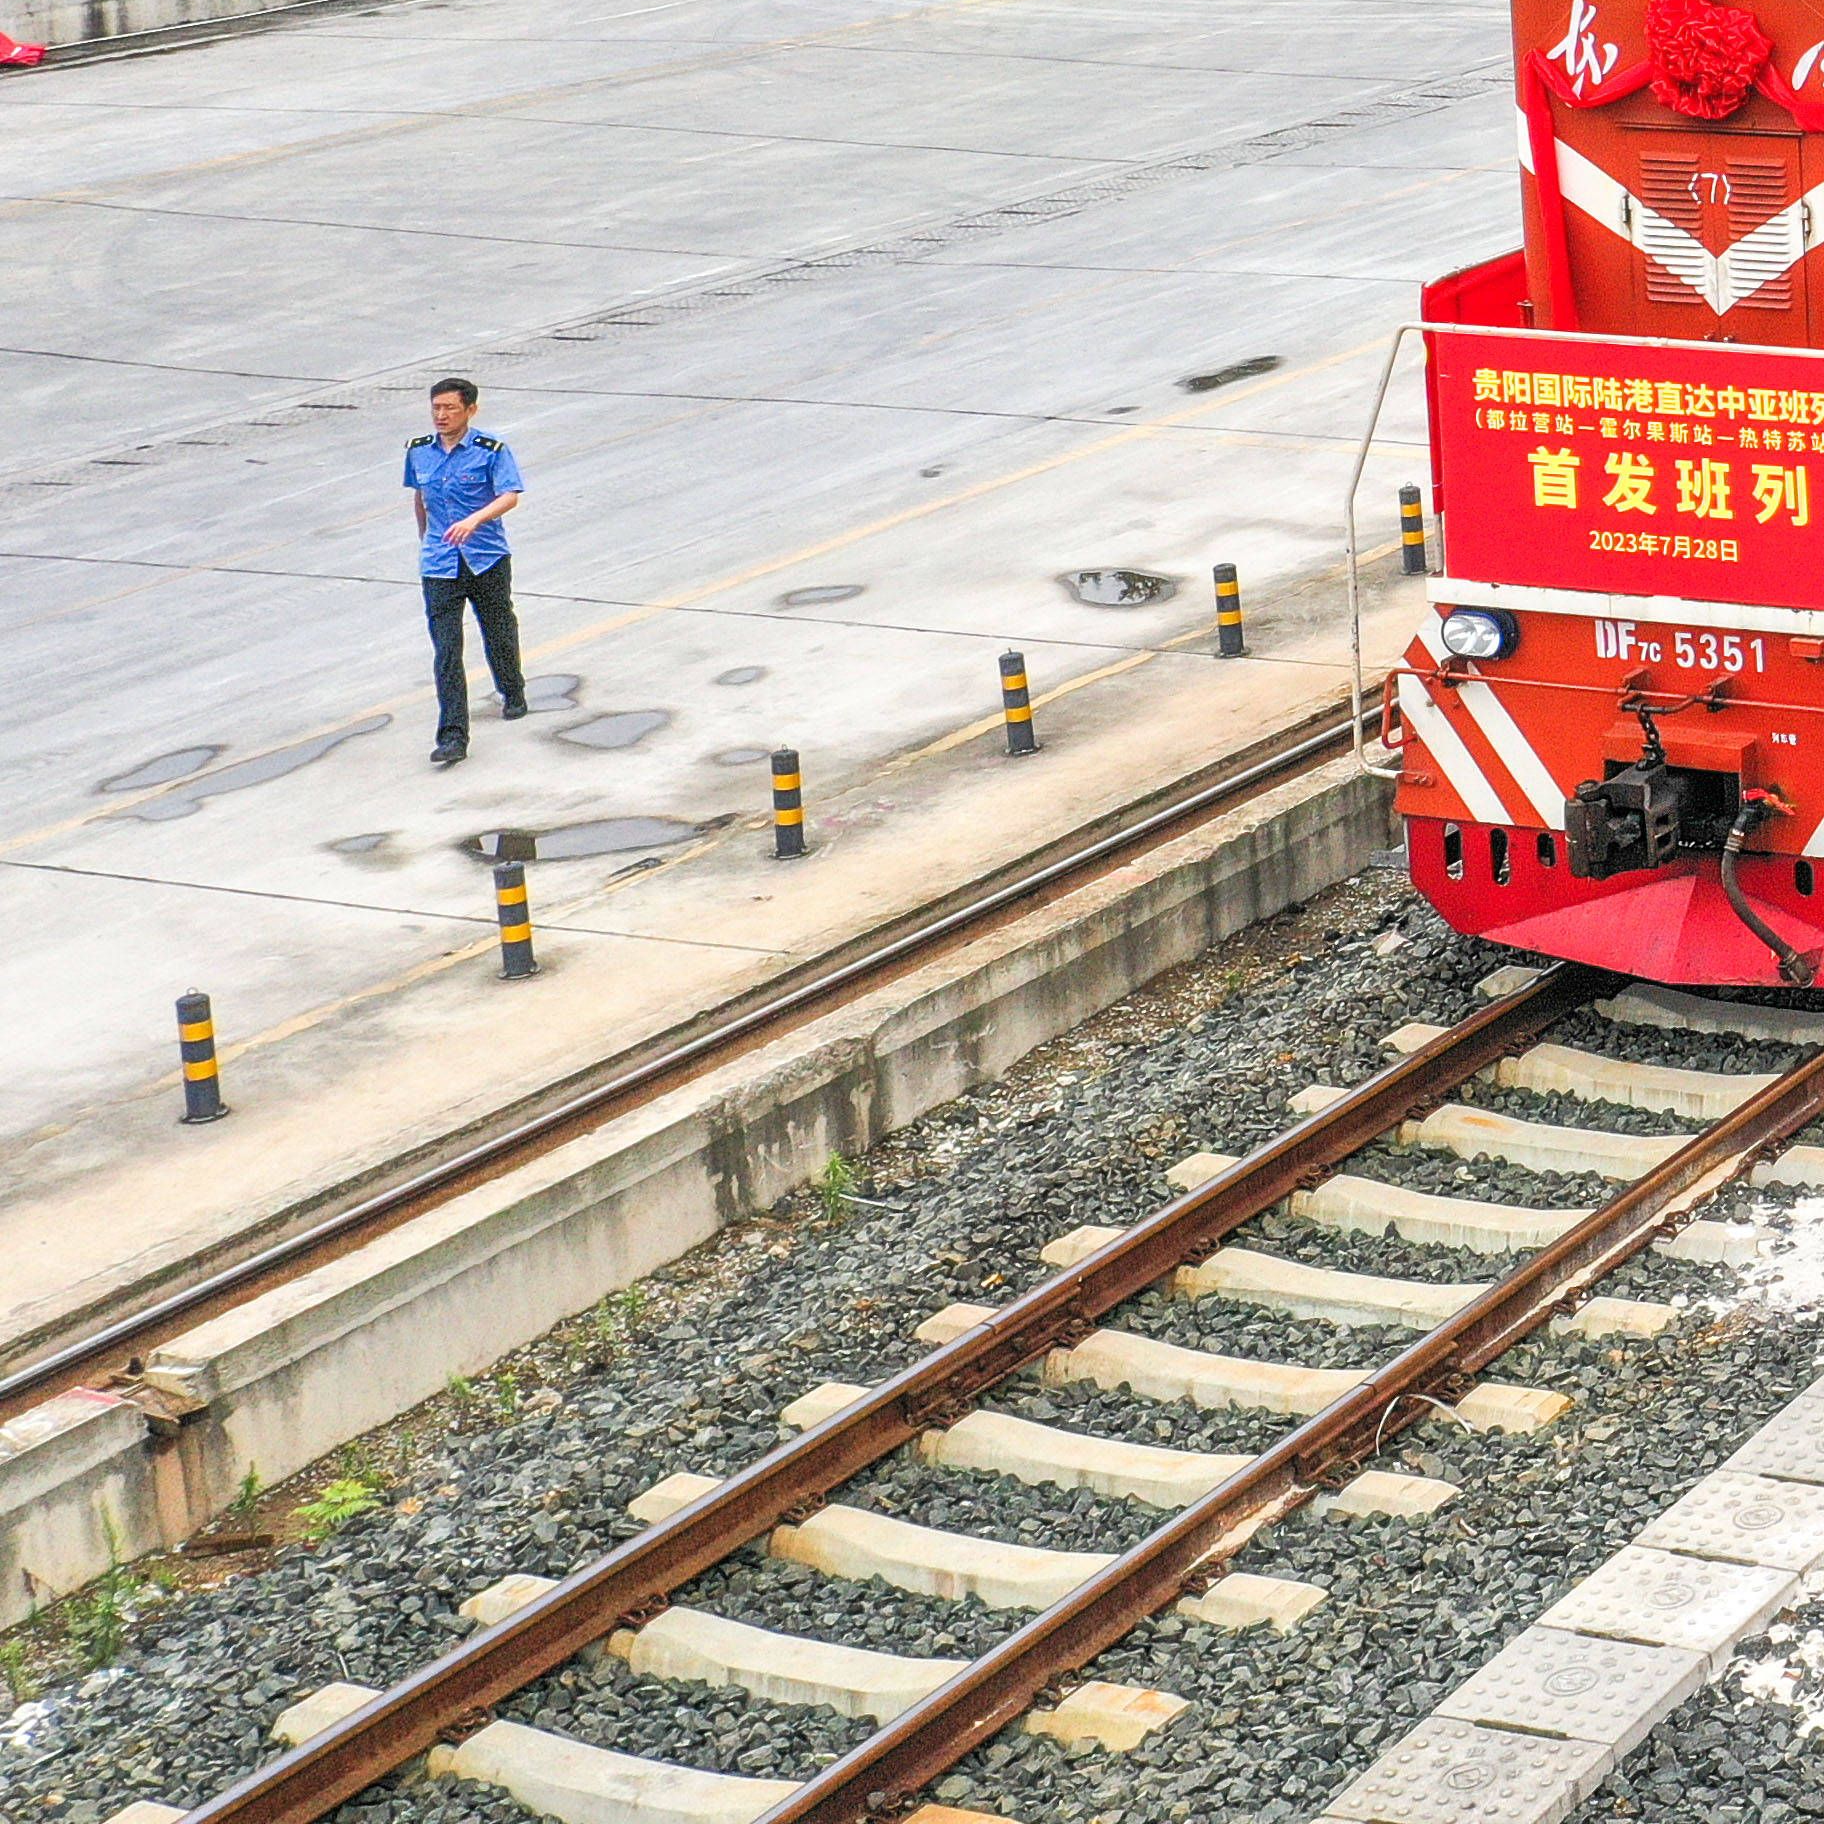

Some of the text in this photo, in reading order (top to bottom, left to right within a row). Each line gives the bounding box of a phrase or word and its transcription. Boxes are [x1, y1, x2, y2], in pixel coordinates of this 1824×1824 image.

[1527, 445, 1810, 527] 首发班列
[1588, 530, 1740, 563] 2023年7月28日
[1674, 631, 1766, 673] 5351
